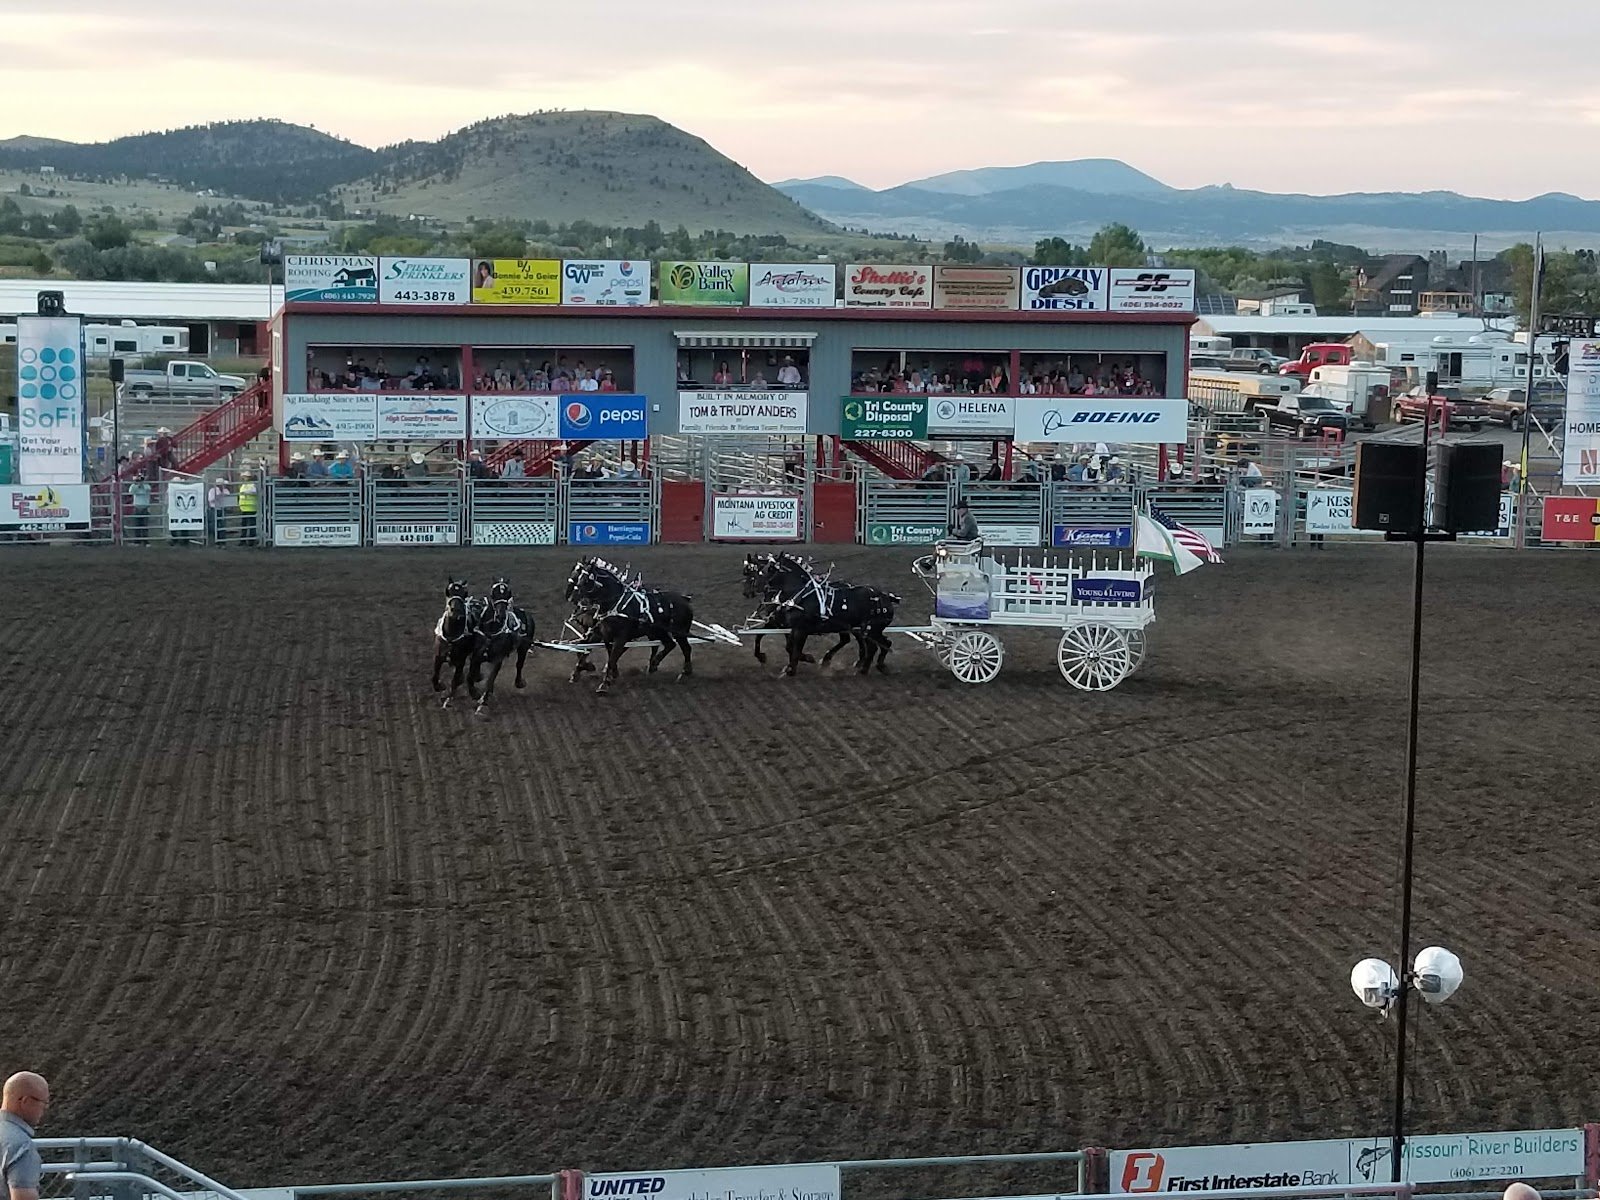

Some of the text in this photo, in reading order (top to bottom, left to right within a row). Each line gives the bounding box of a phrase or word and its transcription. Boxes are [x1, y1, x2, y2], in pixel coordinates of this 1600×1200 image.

[288, 256, 374, 266] CHRISTMAN
[288, 268, 331, 277] ROOFING
[697, 265, 735, 278] Valley
[698, 279, 735, 293] Bank
[852, 285, 895, 298] Country
[395, 291, 455, 301] 443-3878
[1032, 298, 1099, 309] DIESEL
[690, 405, 797, 418] TOM & TRUDY ANDERS
[864, 401, 924, 413] Tri County
[958, 402, 1006, 413] HELENA
[22, 407, 77, 428] SoFi
[600, 409, 643, 424] pepsi
[866, 411, 912, 423] Disposal
[1071, 412, 1161, 423] BOEING
[854, 429, 913, 437] 227-6300
[21, 437, 61, 445] Get Your
[22, 446, 77, 455] Money Right
[717, 501, 795, 510] MONTANA LIVESTOCK
[1326, 495, 1354, 506] KES
[754, 511, 793, 519] AG CREDIT
[890, 526, 943, 536] Tri County
[1469, 1138, 1510, 1156] River
[1514, 1136, 1578, 1154] Builders
[1449, 1165, 1525, 1180] (406) 227-2201
[1167, 1169, 1339, 1192] First Interstate Bank
[591, 1177, 666, 1196] UNITED
